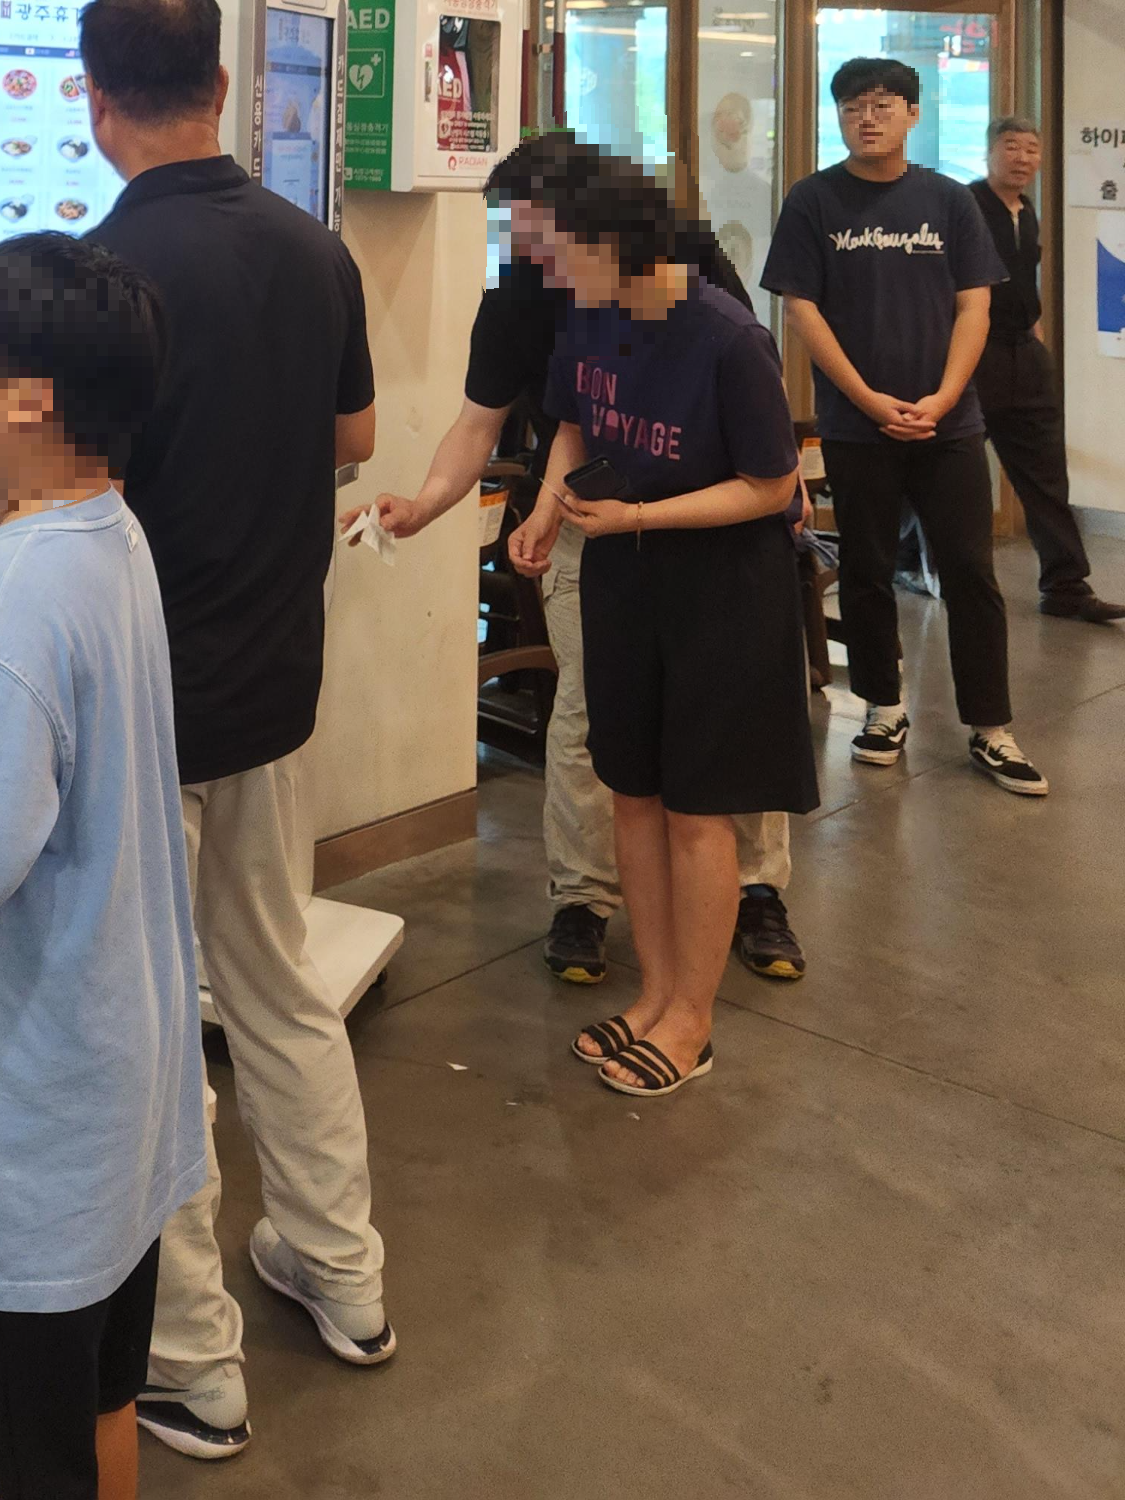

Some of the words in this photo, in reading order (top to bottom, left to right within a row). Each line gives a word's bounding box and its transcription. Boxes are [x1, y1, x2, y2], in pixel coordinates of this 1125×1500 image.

[347, 9, 391, 30] AED
[577, 361, 617, 406] BON
[592, 404, 682, 460] VOYAGE
